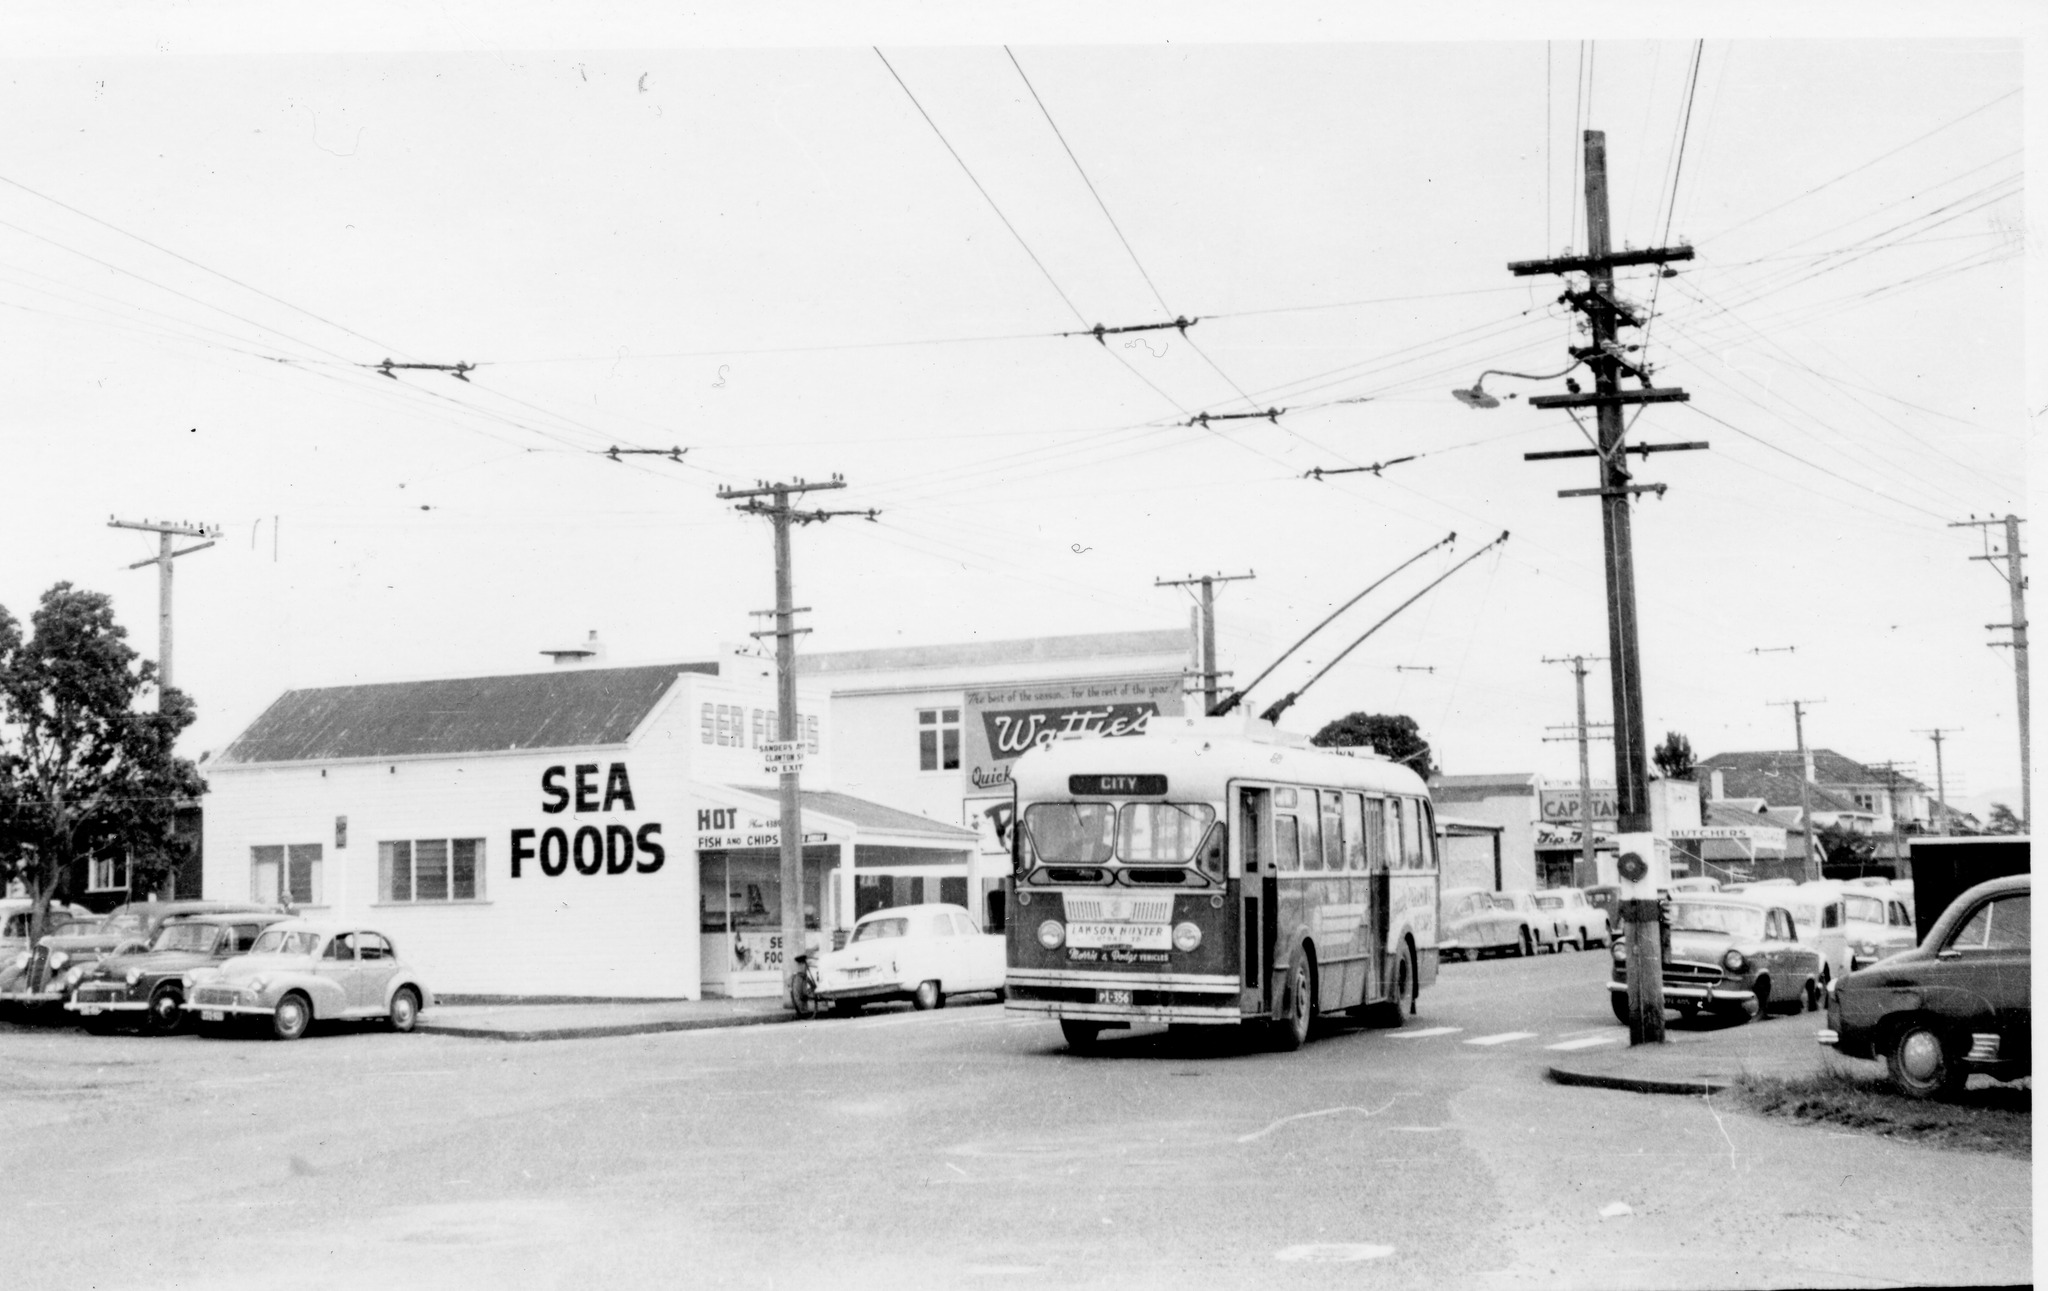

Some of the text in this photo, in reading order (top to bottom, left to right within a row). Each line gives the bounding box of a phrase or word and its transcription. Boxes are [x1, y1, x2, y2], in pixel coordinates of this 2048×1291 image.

[700, 702, 819, 755] SEA FODS
[995, 705, 1154, 752] Wattie's
[759, 744, 793, 752] SANDERS
[783, 764, 804, 772] EXIT
[542, 762, 635, 814] SEA
[1101, 777, 1138, 790] CITY
[1544, 800, 1619, 817] CAPTAN
[697, 808, 737, 831] HOT
[698, 834, 779, 848] FISH AND CHIPS
[1671, 830, 1747, 838] BUTCHERS
[511, 822, 665, 878] FOODS
